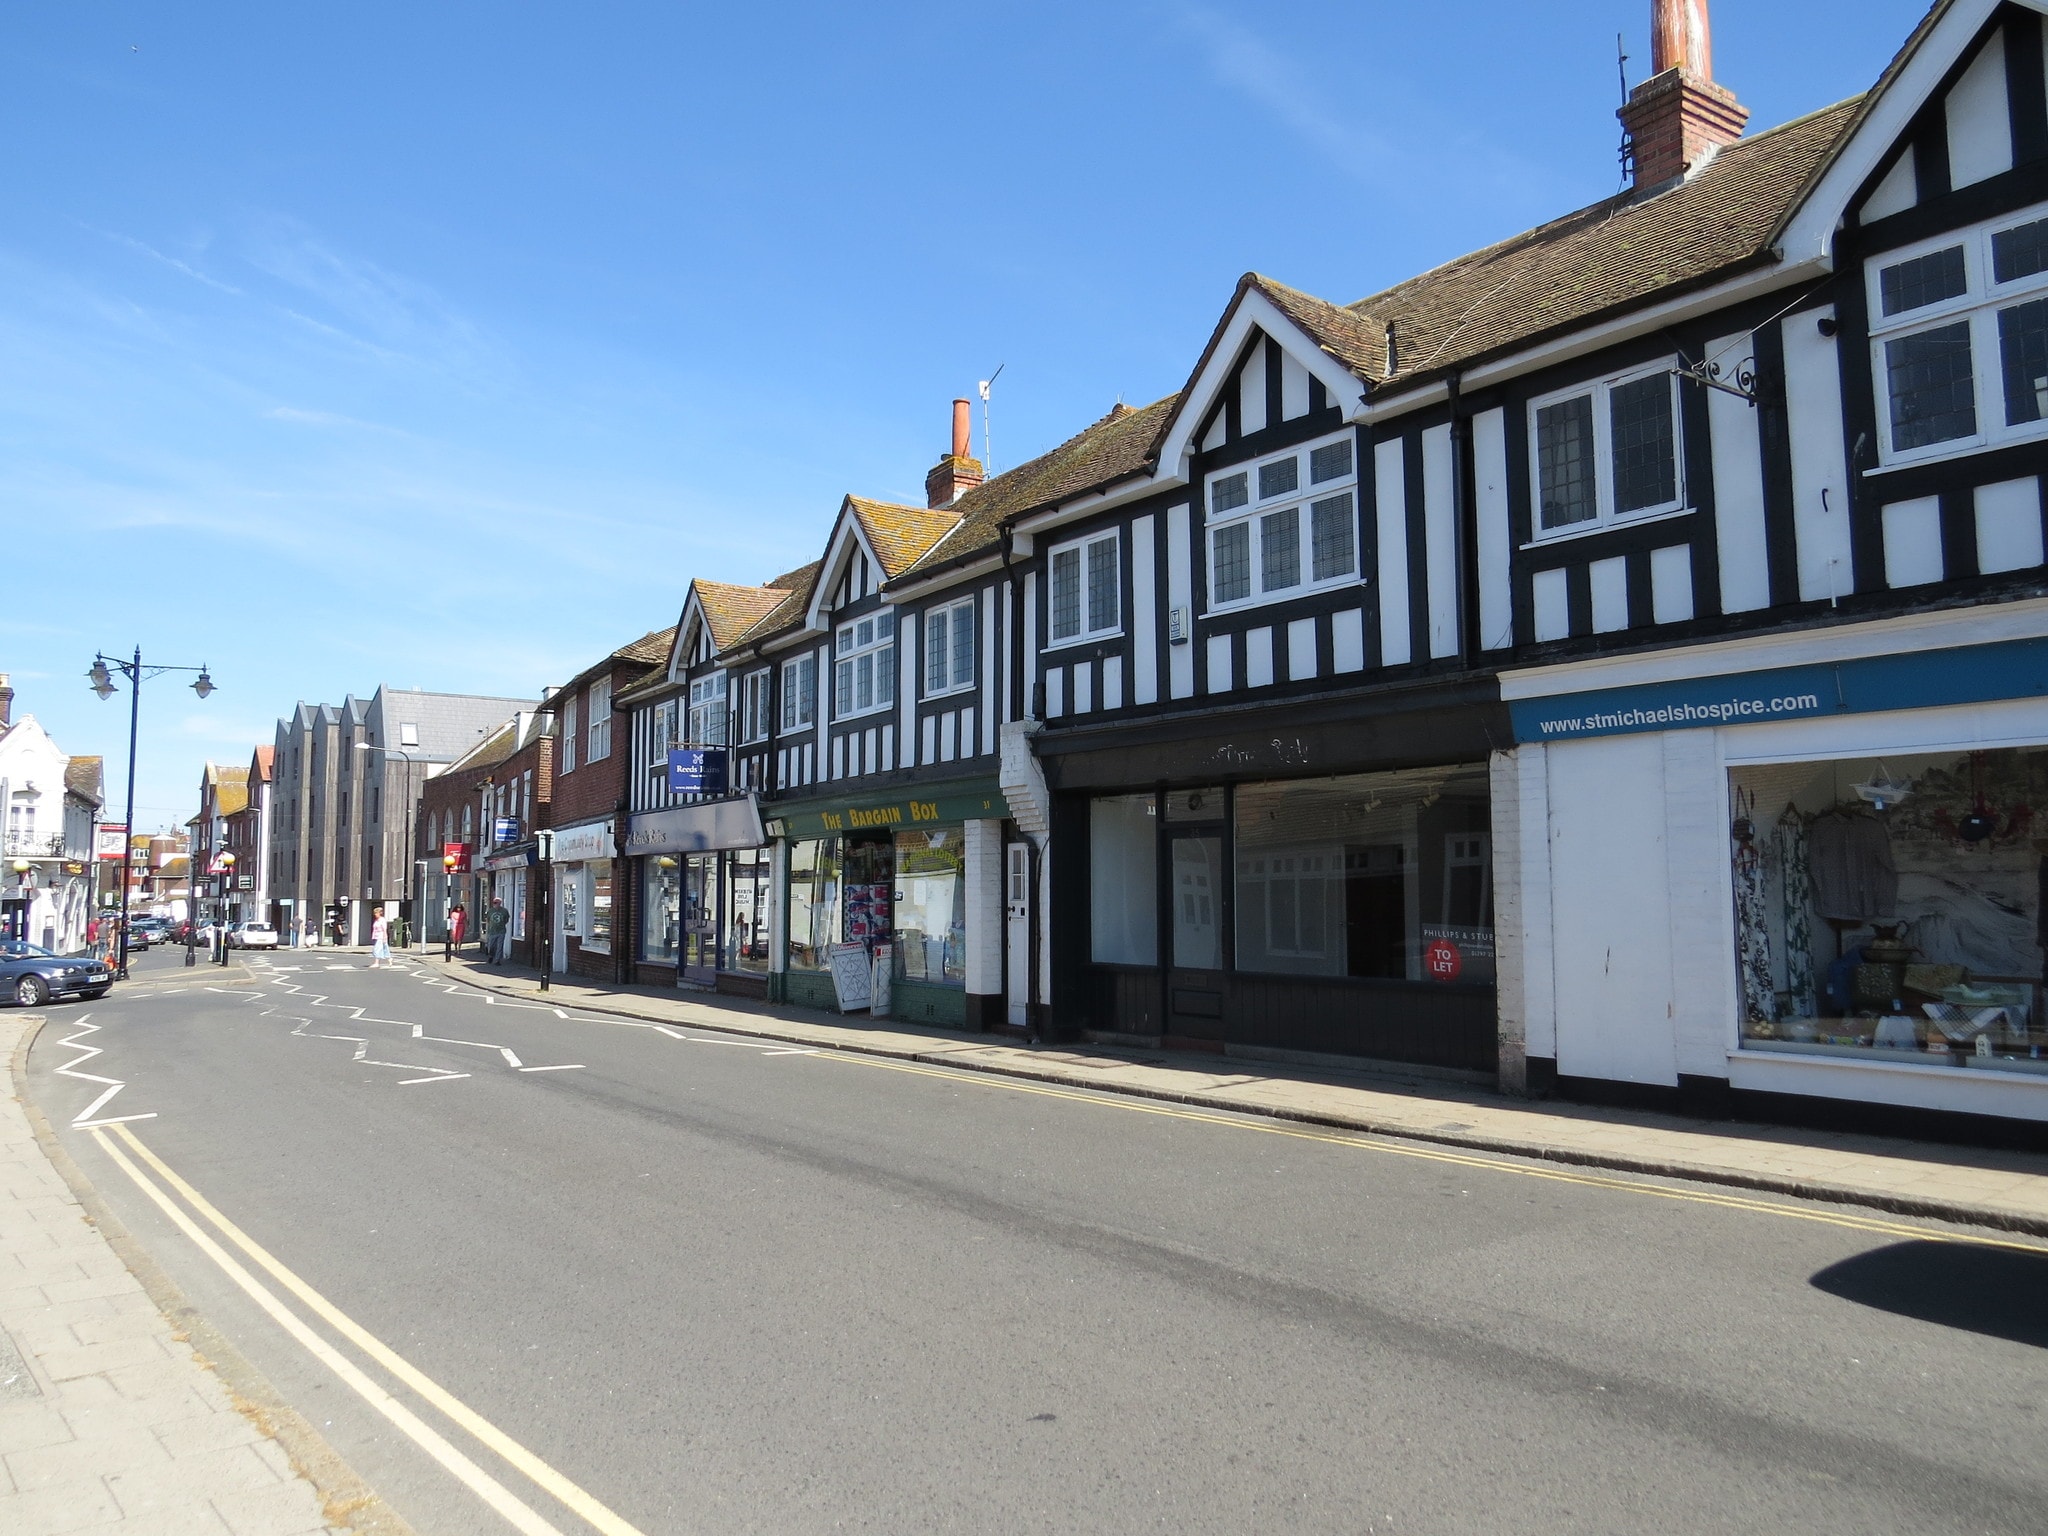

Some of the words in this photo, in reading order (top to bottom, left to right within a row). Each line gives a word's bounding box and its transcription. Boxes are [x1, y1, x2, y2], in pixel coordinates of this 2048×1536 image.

[1540, 693, 1818, 734] www.stmichaelshospice.com
[676, 765, 698, 773] Reeds
[699, 765, 721, 774] Rains
[821, 811, 843, 831] THE
[848, 806, 902, 828] BARGAIN
[909, 800, 939, 821] BOX
[1423, 928, 1459, 939] PHILLIPS
[1462, 932, 1467, 940] &
[1434, 948, 1451, 960] TO
[1433, 961, 1453, 973] LET
